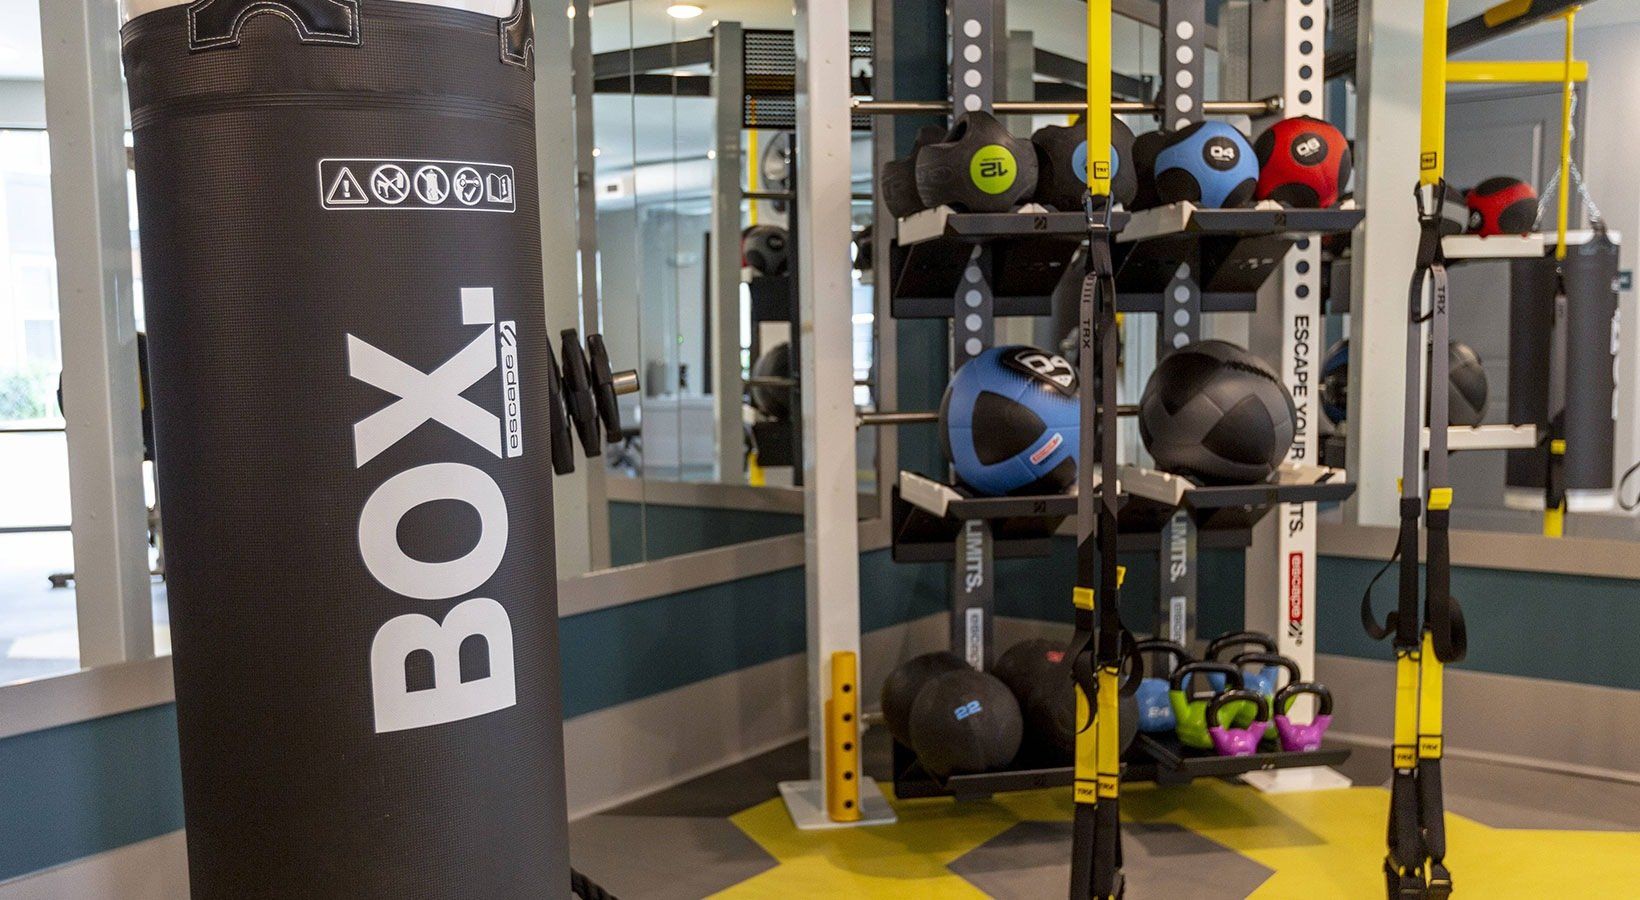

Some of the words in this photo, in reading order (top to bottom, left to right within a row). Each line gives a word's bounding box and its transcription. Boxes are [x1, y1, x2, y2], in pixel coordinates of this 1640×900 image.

[980, 161, 1008, 177] 12
[1210, 145, 1235, 160] 04
[1437, 285, 1446, 315] TRX
[1083, 318, 1091, 348] TRX
[1293, 315, 1309, 397] ESCAPE
[1291, 403, 1307, 461] YOUR
[347, 287, 517, 733] BOX.
[965, 519, 983, 593] LIMITS.
[1170, 509, 1187, 582] LIMITS.
[954, 700, 983, 720] 22
